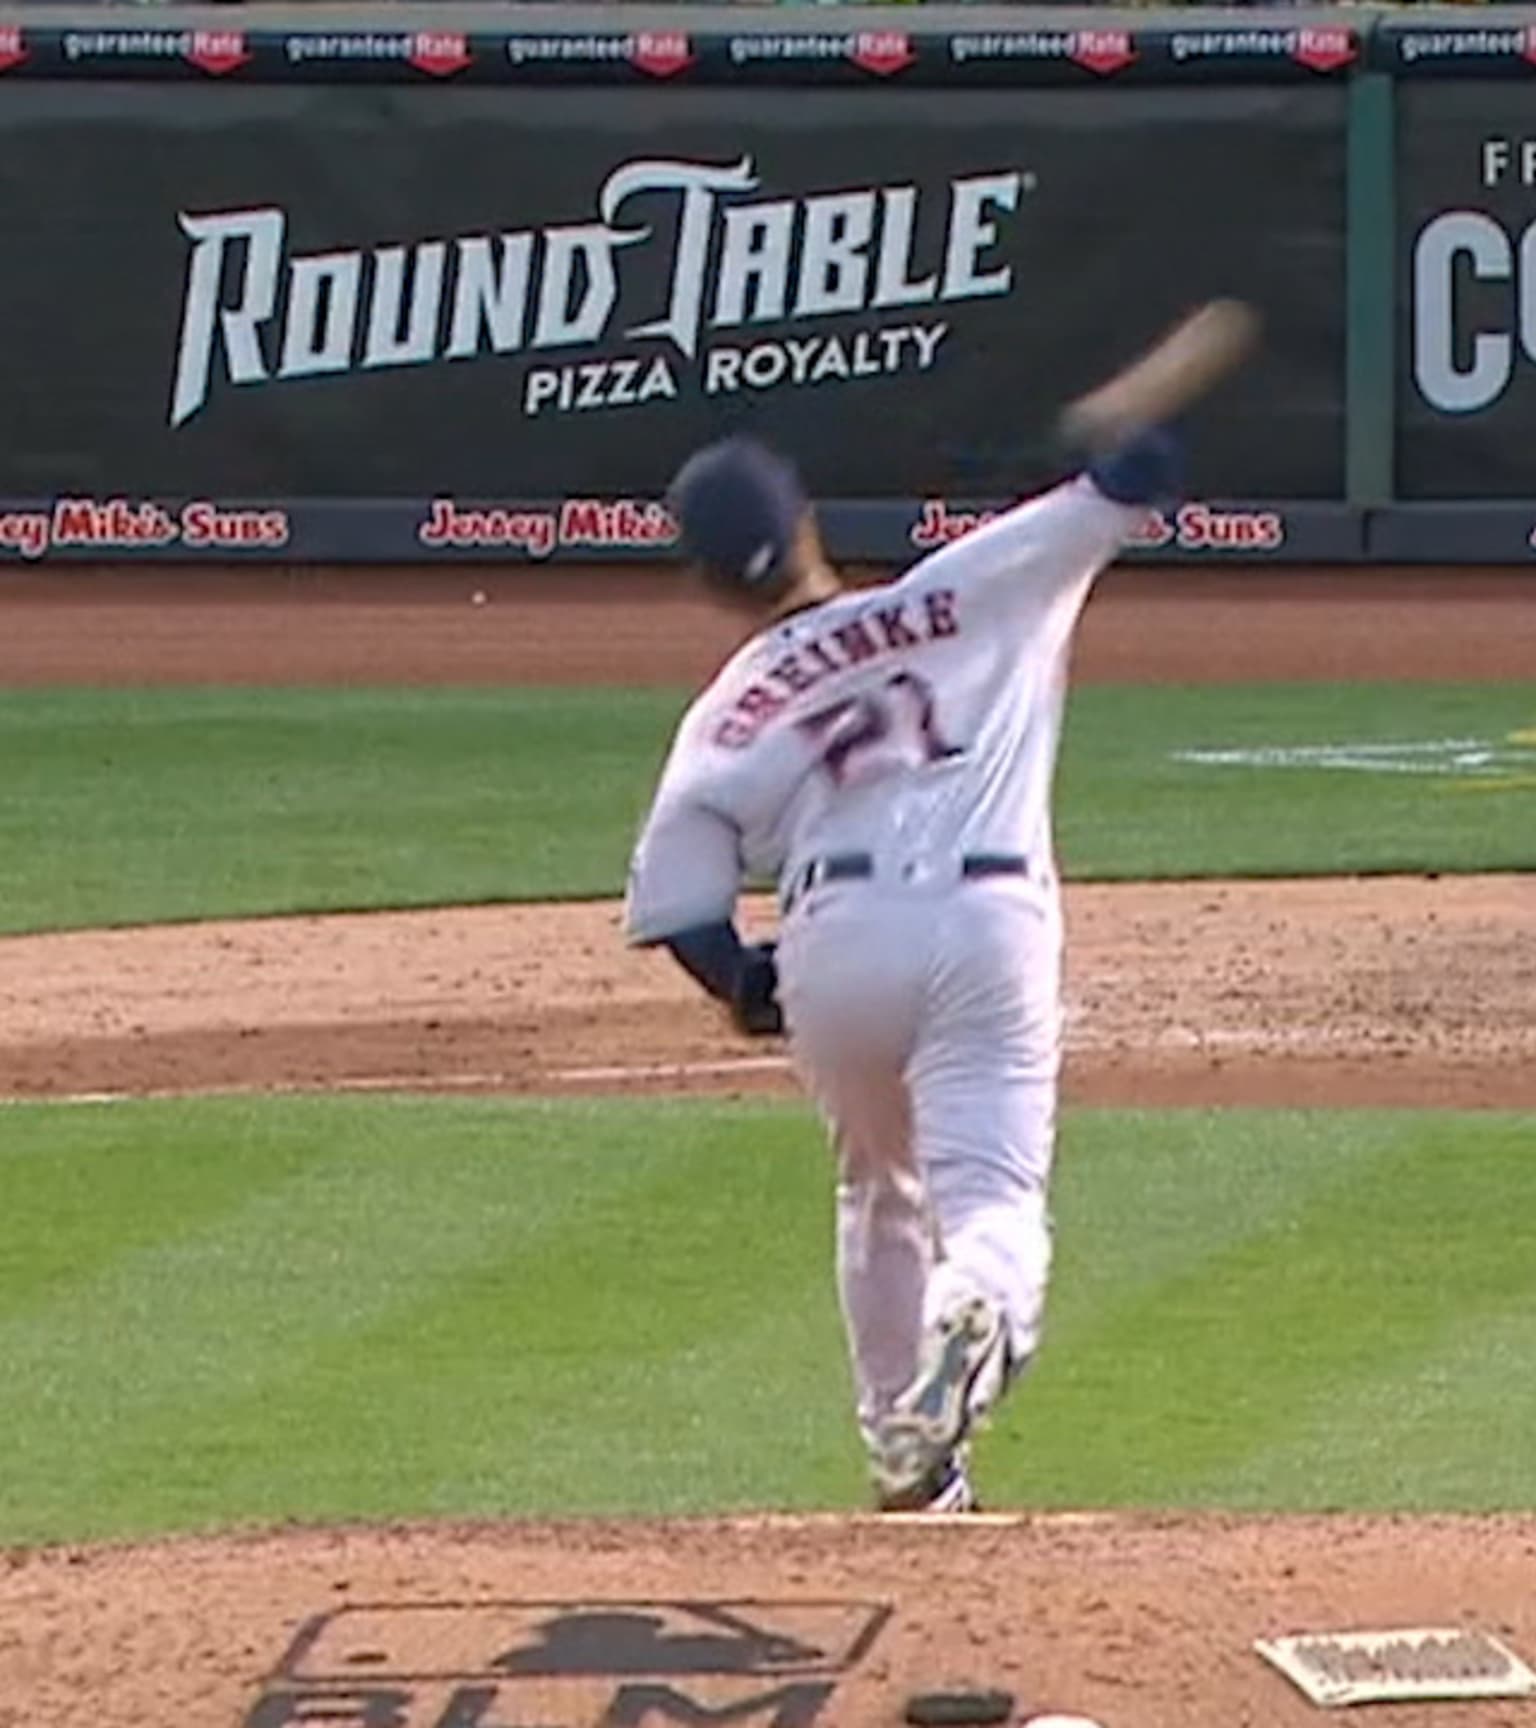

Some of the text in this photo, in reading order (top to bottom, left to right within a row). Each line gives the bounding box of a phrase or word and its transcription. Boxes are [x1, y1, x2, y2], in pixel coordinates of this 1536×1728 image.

[524, 323, 946, 416] PIZZA ROYALTY
[420, 499, 555, 557] Jersey
[715, 588, 959, 750] GREINKE
[799, 671, 968, 788] 21
